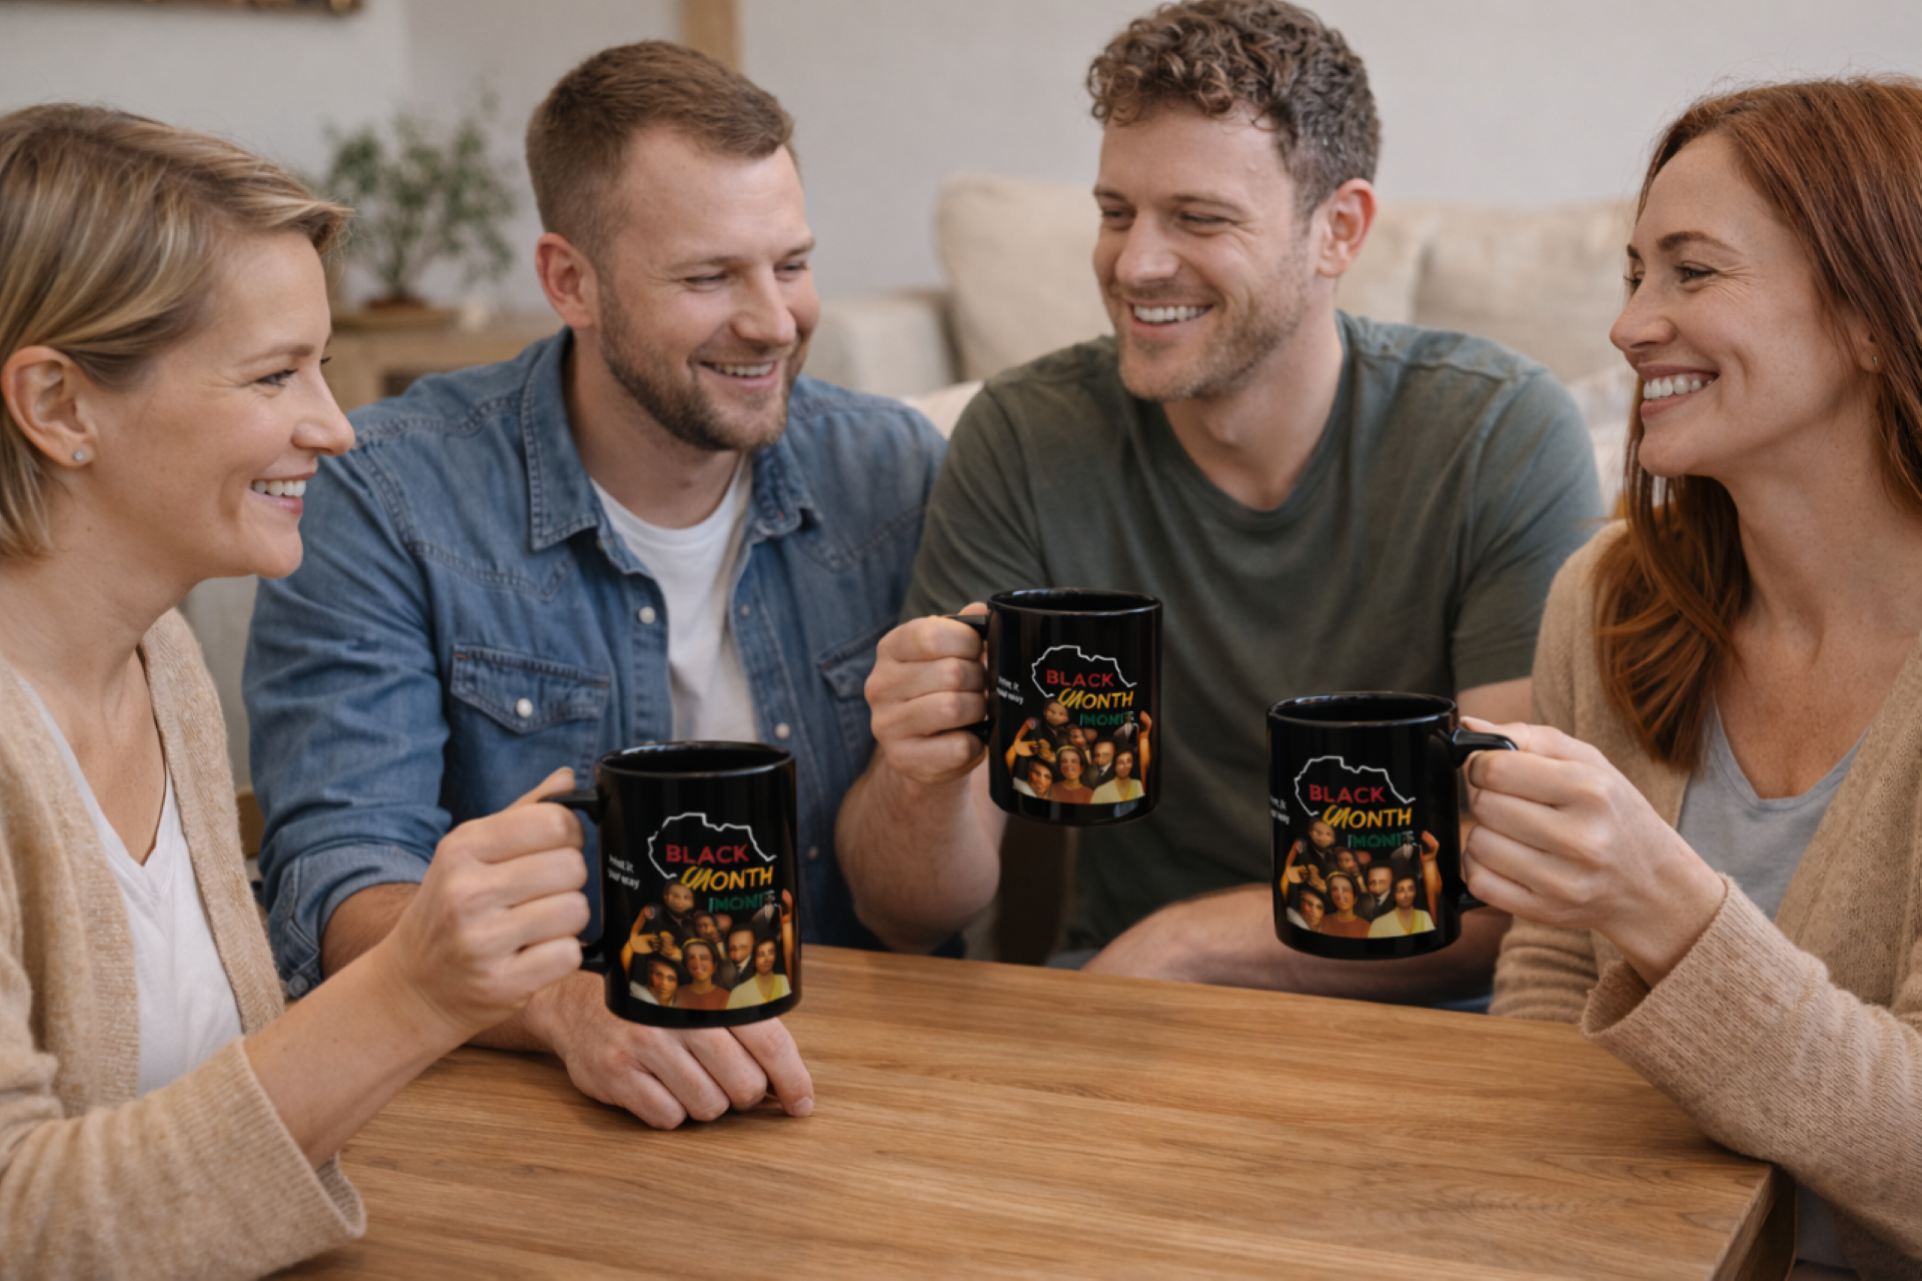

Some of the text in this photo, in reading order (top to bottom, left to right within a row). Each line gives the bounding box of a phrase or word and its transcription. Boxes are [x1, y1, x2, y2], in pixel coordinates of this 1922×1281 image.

[1046, 669, 1114, 688] BLACK
[1057, 687, 1134, 710] MONTH
[1309, 784, 1386, 804] BLACK
[1322, 804, 1412, 830] MONTH
[666, 844, 749, 865] BLACK
[680, 865, 774, 892] MONTH
